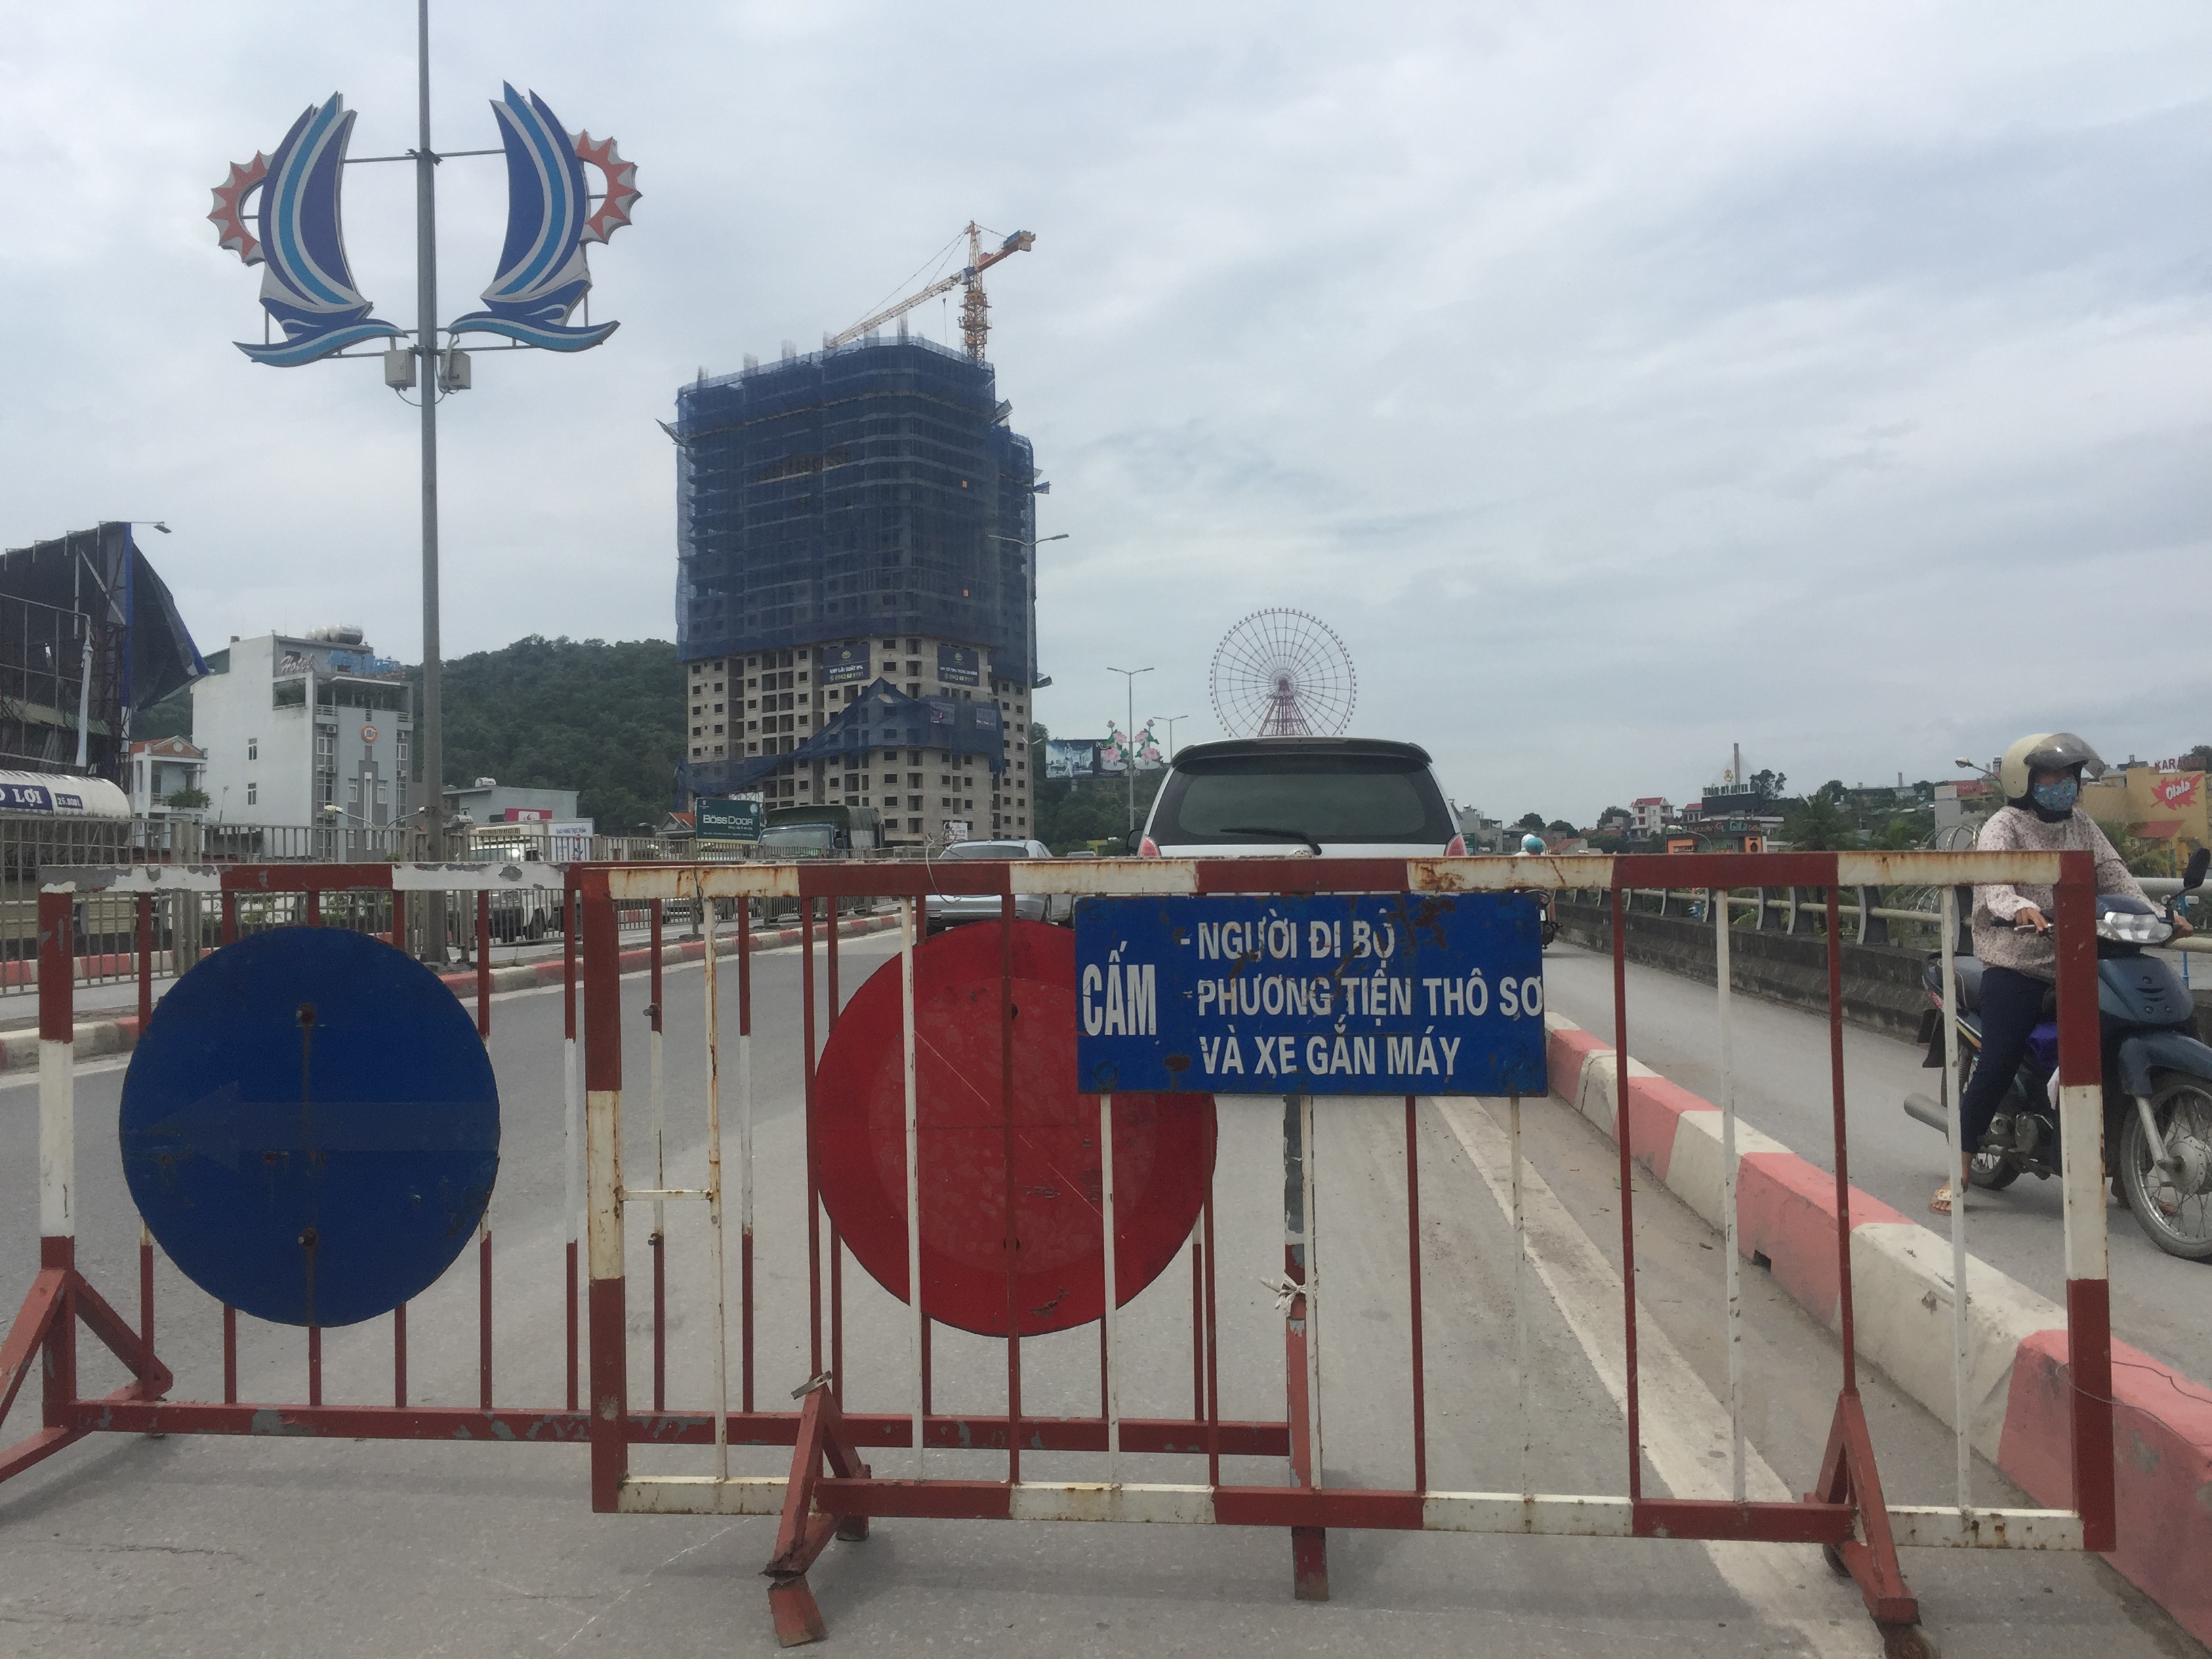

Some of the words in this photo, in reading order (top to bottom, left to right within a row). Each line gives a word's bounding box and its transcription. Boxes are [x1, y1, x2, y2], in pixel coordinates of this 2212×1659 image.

[280, 653, 314, 673] Hotel
[12, 788, 43, 806] LỢI
[2165, 779, 2190, 800] Olala
[1198, 909, 1297, 960] NGƯỜI
[1309, 920, 1341, 959] ĐI
[1352, 908, 1395, 968] BỘ
[1082, 941, 1157, 1036] CẤM
[1197, 973, 1332, 1017] PHƯƠNG
[1341, 969, 1412, 1027] TIỆN
[1422, 968, 1489, 1017] THÔ
[1499, 976, 1544, 1017] SƠ
[1199, 1024, 1244, 1076] VÀ
[1254, 1036, 1298, 1076] XE
[1306, 1015, 1377, 1076] GẮN
[1387, 1025, 1462, 1076] MÁY
